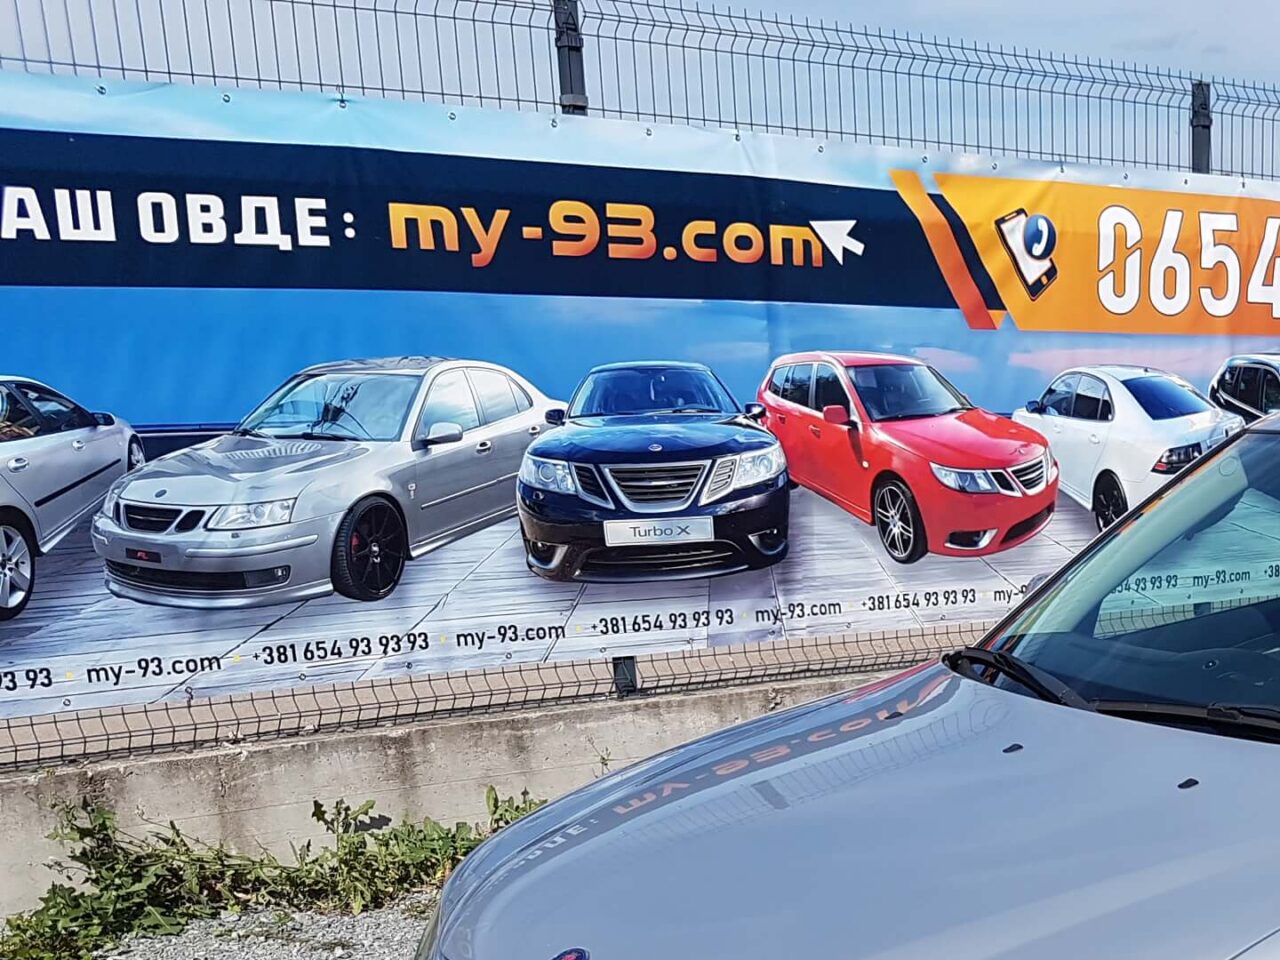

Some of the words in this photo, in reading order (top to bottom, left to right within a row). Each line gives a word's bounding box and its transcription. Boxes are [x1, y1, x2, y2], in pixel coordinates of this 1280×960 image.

[136, 191, 357, 251] ОВДЕ:
[387, 199, 824, 268] my-93.com
[628, 525, 674, 538] Turbo
[676, 525, 691, 536] X
[1134, 577, 1147, 593] 93
[1150, 575, 1163, 590] 93
[1166, 574, 1178, 589] 93
[1192, 570, 1251, 588] my-93.com
[0, 671, 18, 691] 3
[25, 667, 53, 689] 93
[86, 656, 222, 686] my-93.com
[252, 643, 298, 665] +381
[303, 639, 343, 661] 654
[349, 636, 372, 657] 93
[378, 634, 401, 655] 93
[407, 632, 430, 651] 93
[456, 624, 566, 650] my-93.com
[591, 615, 628, 635] +381
[632, 613, 664, 632] 654
[669, 612, 688, 629] 93
[693, 610, 711, 628] 93
[716, 608, 734, 626] 93
[755, 601, 842, 625] my-93.com
[861, 595, 891, 612] +381
[894, 592, 920, 609] 654
[924, 591, 939, 607] 93
[943, 590, 958, 606] 93
[961, 588, 976, 604] 93
